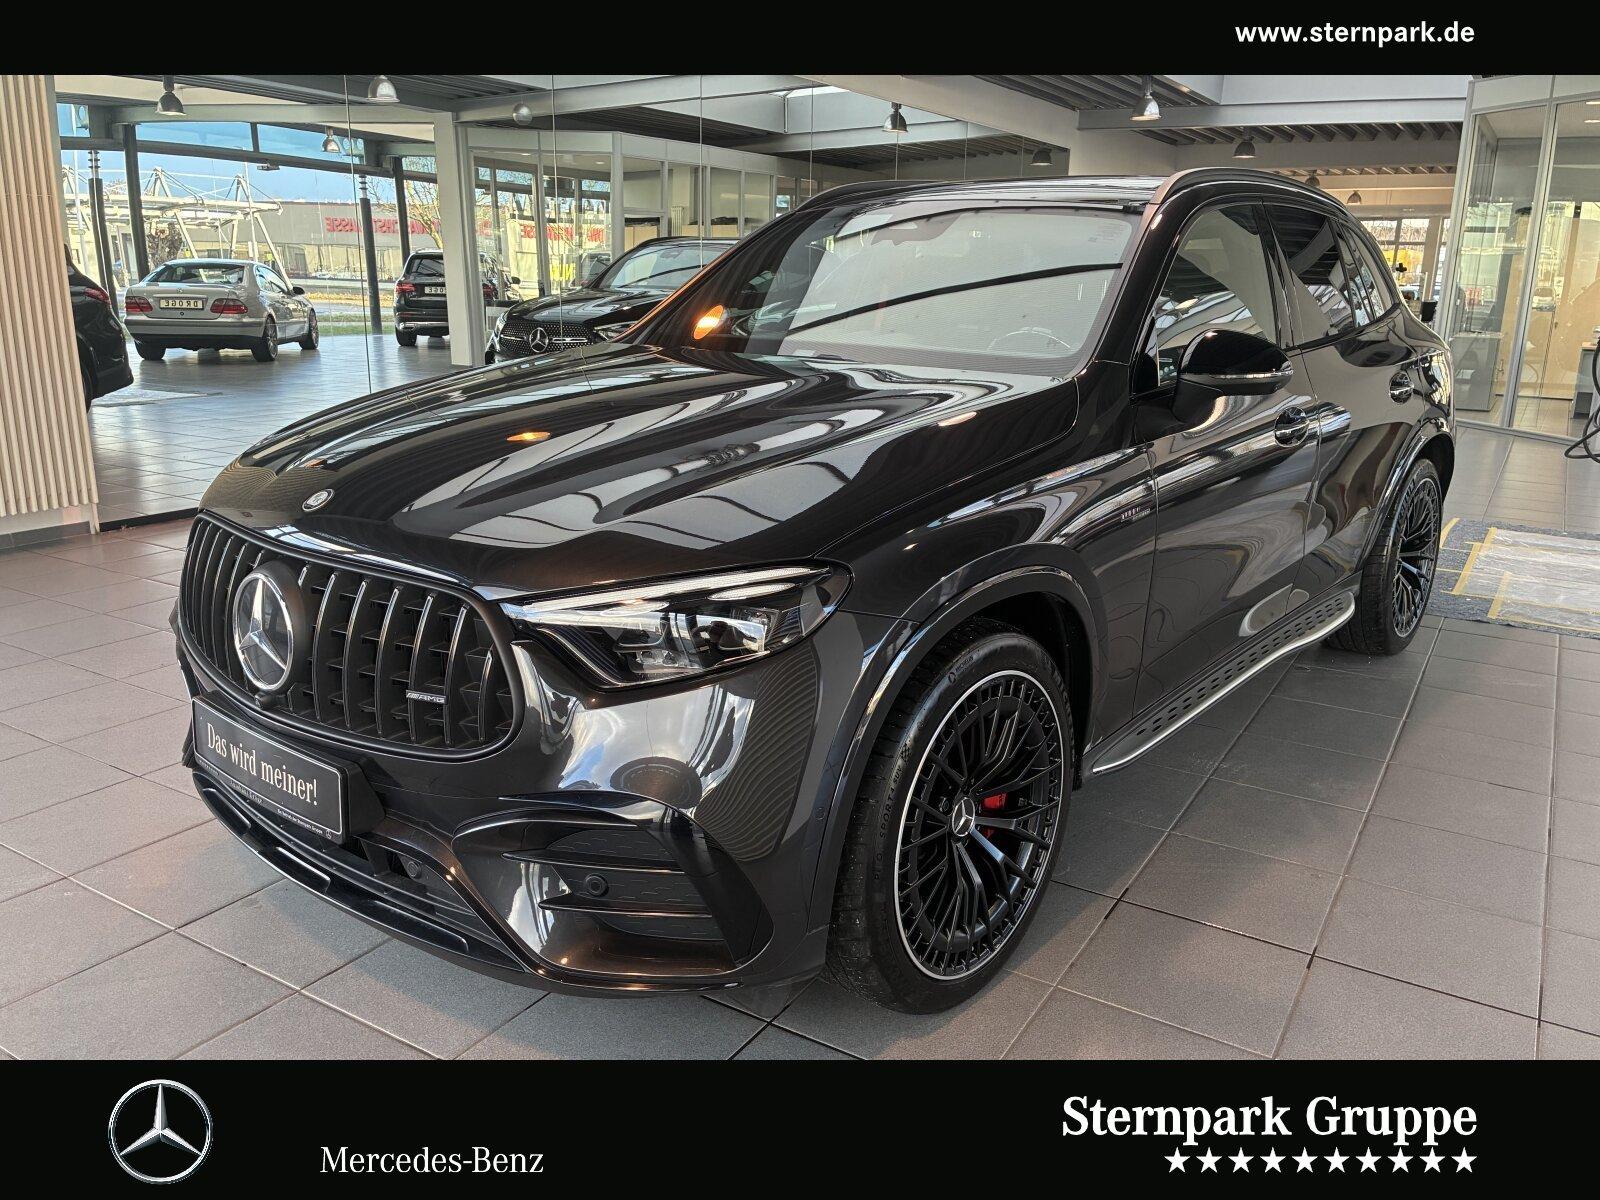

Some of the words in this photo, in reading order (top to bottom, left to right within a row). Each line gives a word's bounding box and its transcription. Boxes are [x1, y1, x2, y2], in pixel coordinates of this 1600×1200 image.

[207, 722, 228, 758] Das
[229, 742, 258, 777] wird
[260, 761, 318, 806] meiner!
[880, 795, 896, 839] SPORT
